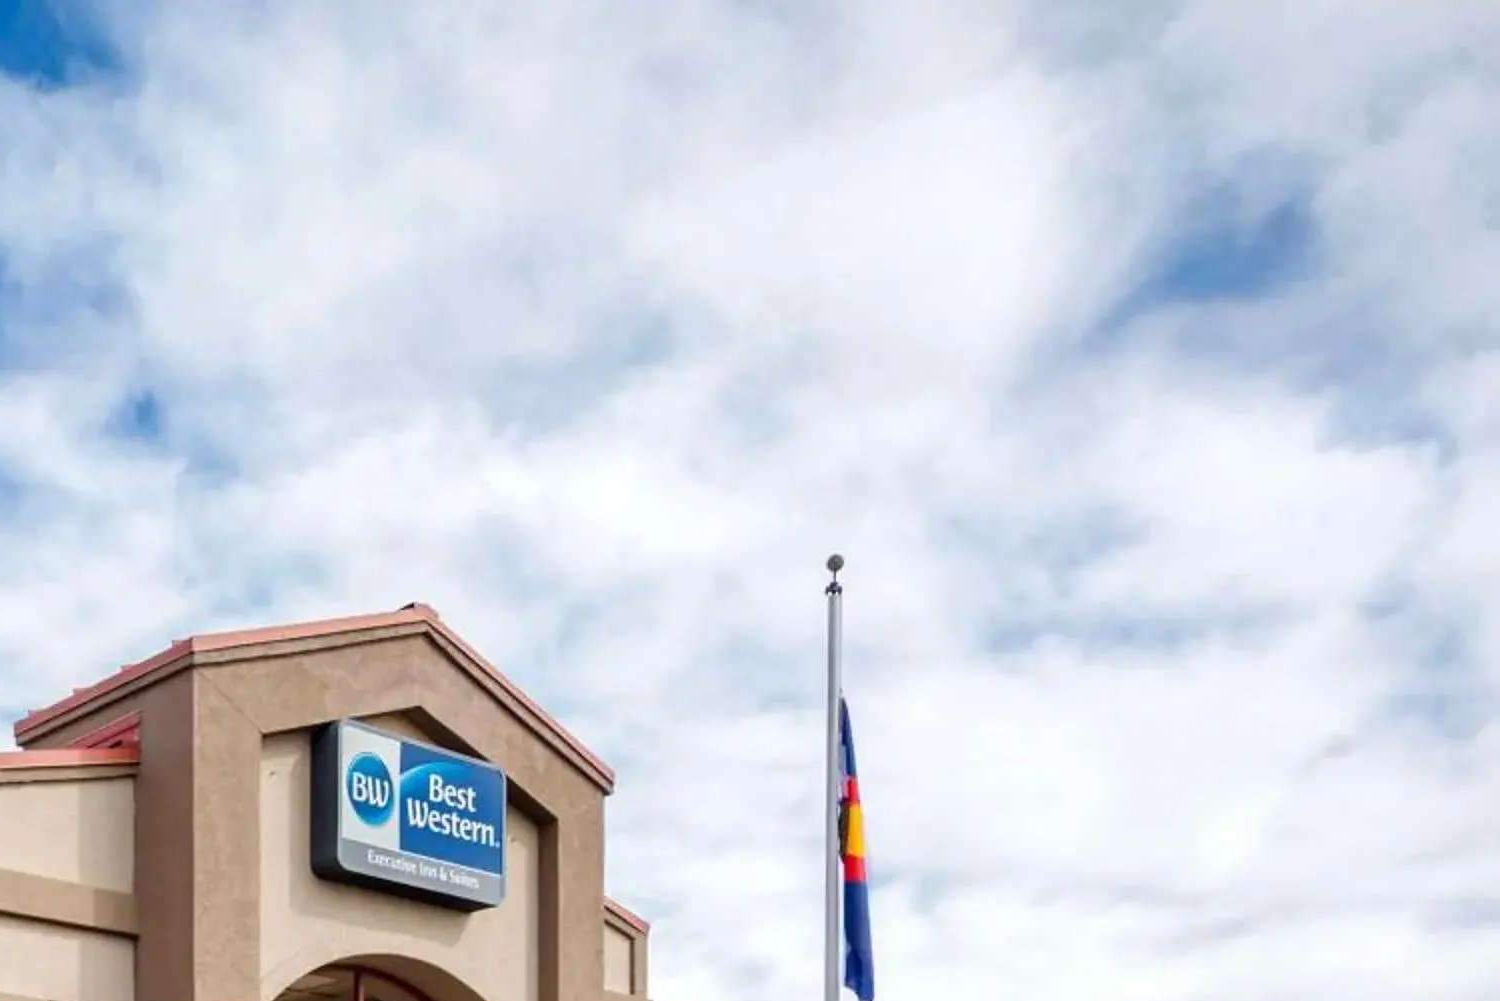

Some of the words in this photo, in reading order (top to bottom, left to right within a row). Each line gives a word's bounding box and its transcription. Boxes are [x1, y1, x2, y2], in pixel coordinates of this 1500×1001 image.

[352, 771, 388, 807] BW
[429, 773, 476, 812] Best
[367, 850, 416, 875] Executive
[420, 861, 437, 879] Inn
[439, 866, 448, 881] &
[449, 870, 479, 889] Suites
